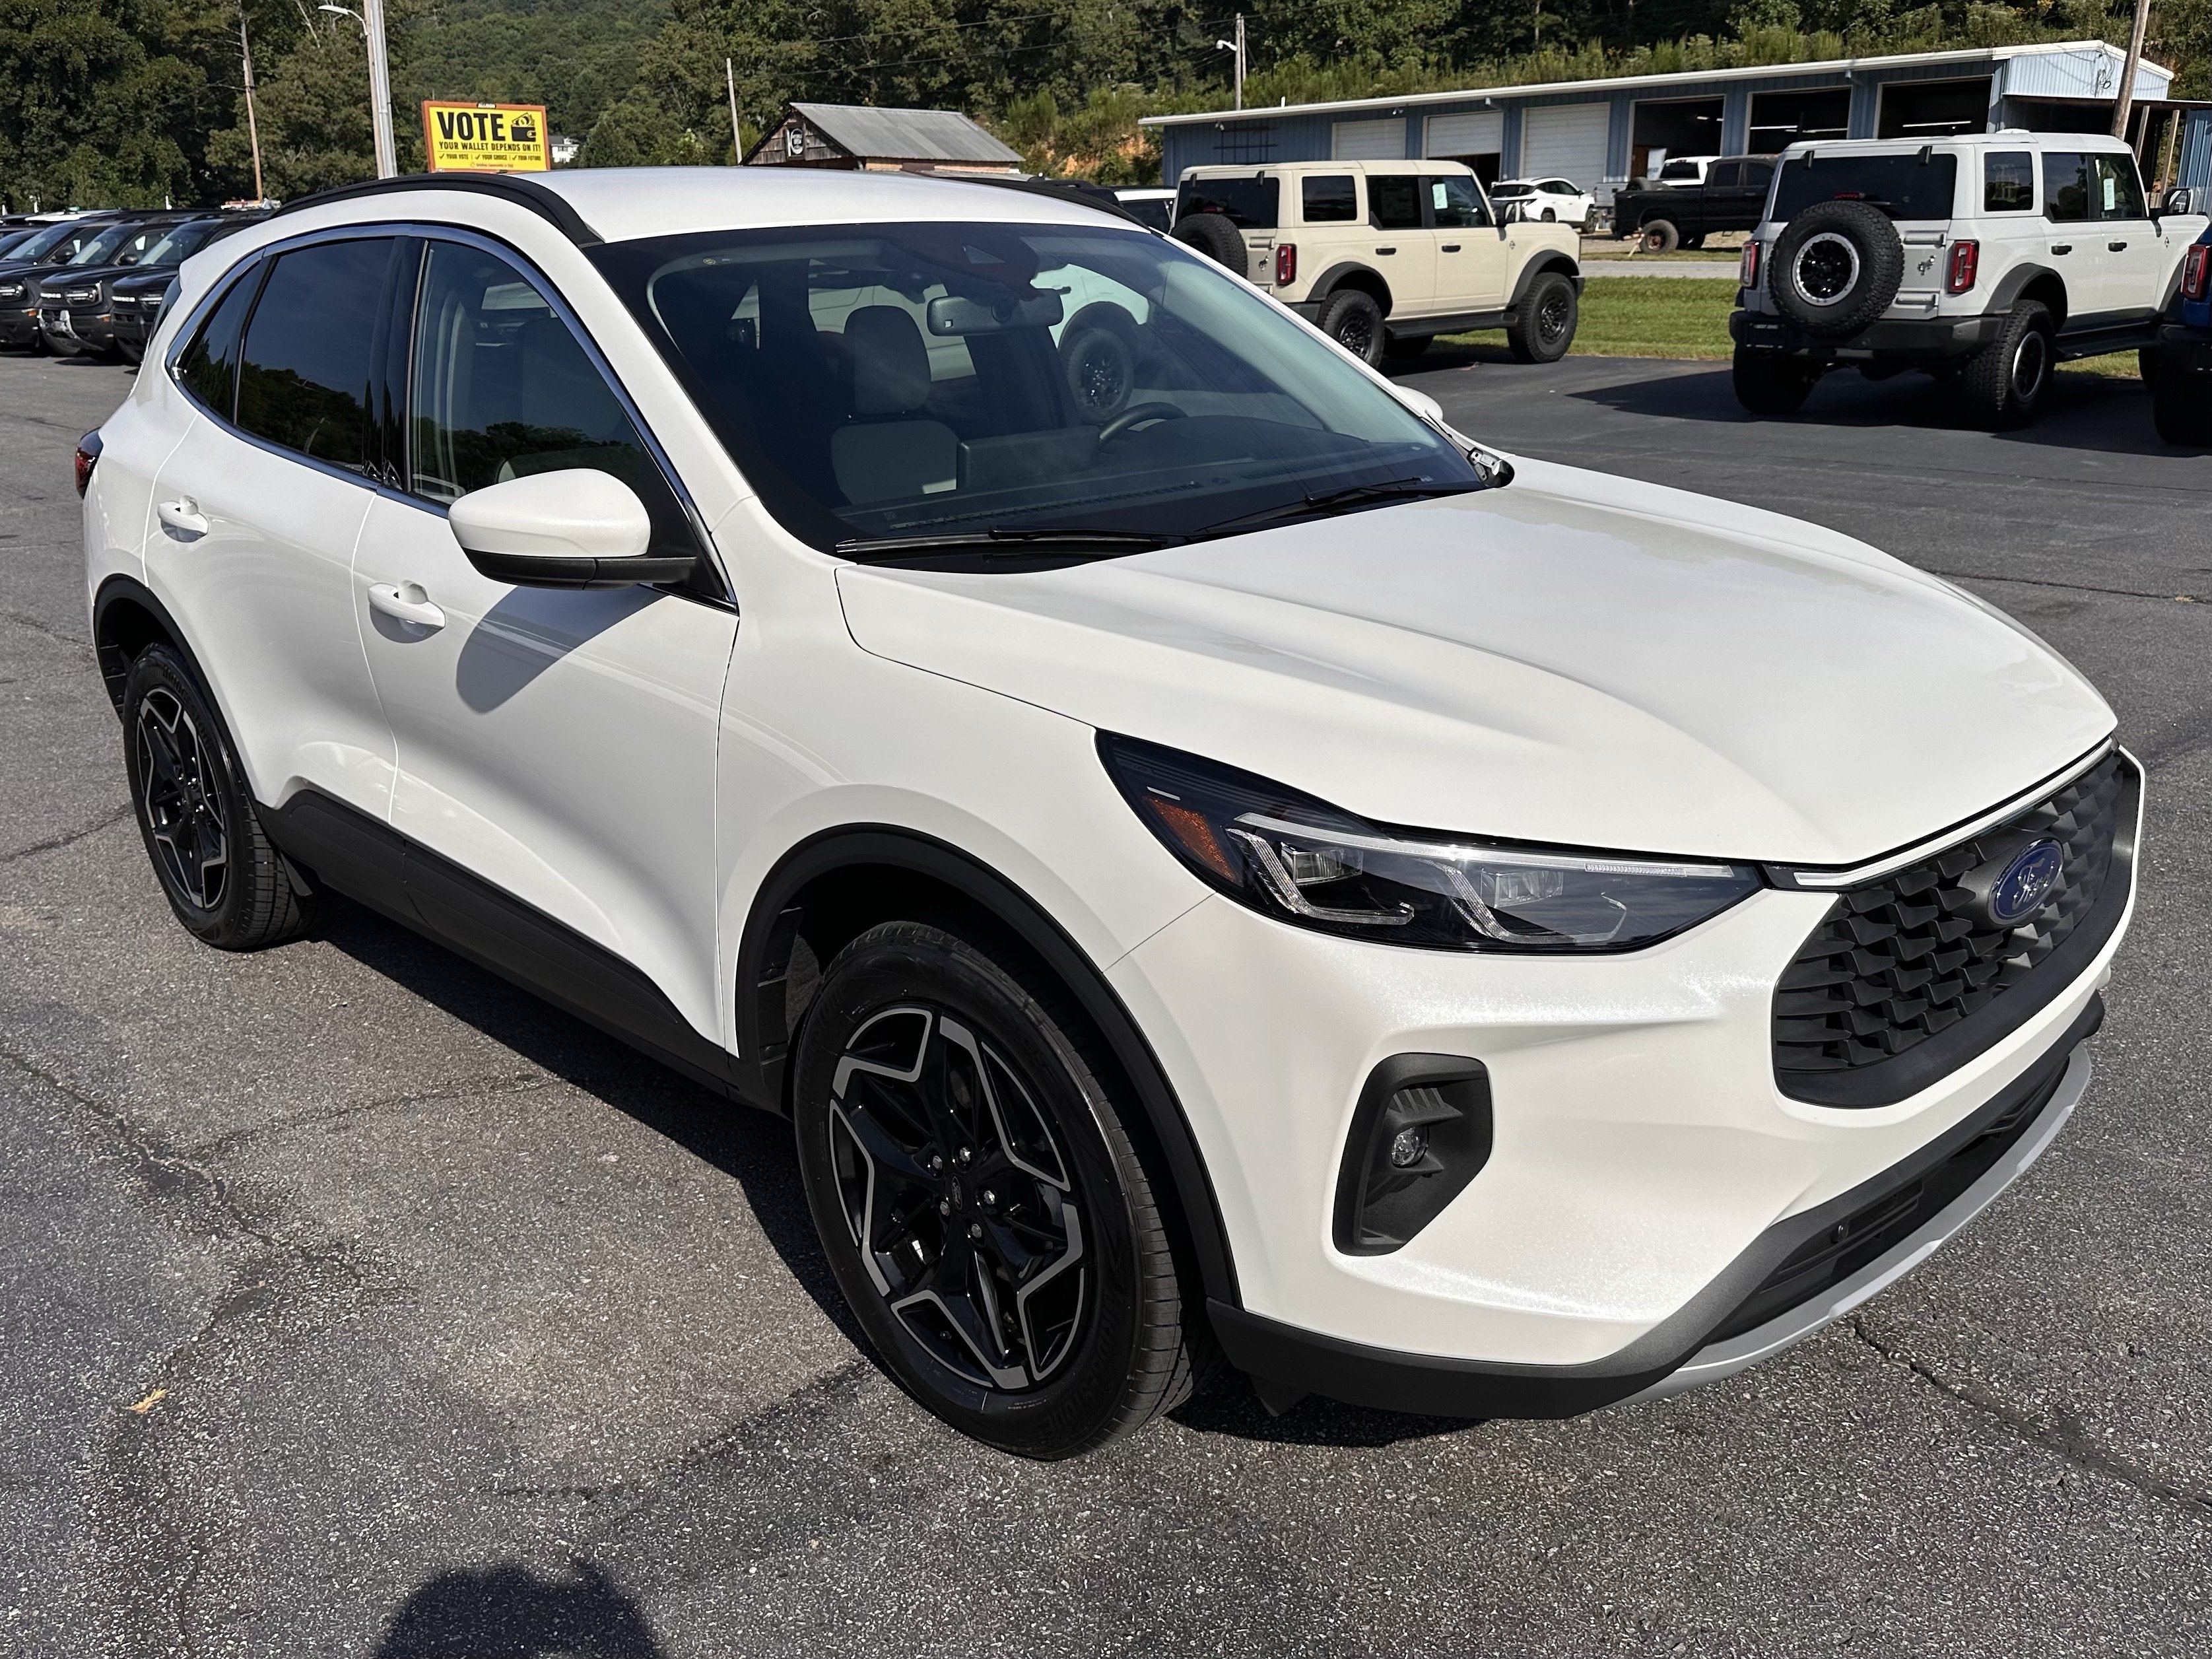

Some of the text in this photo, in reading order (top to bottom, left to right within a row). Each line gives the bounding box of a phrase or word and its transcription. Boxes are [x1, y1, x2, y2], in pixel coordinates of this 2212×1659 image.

[436, 111, 506, 141] VOTE
[439, 141, 459, 150] YOUR
[461, 142, 488, 151] WALLET
